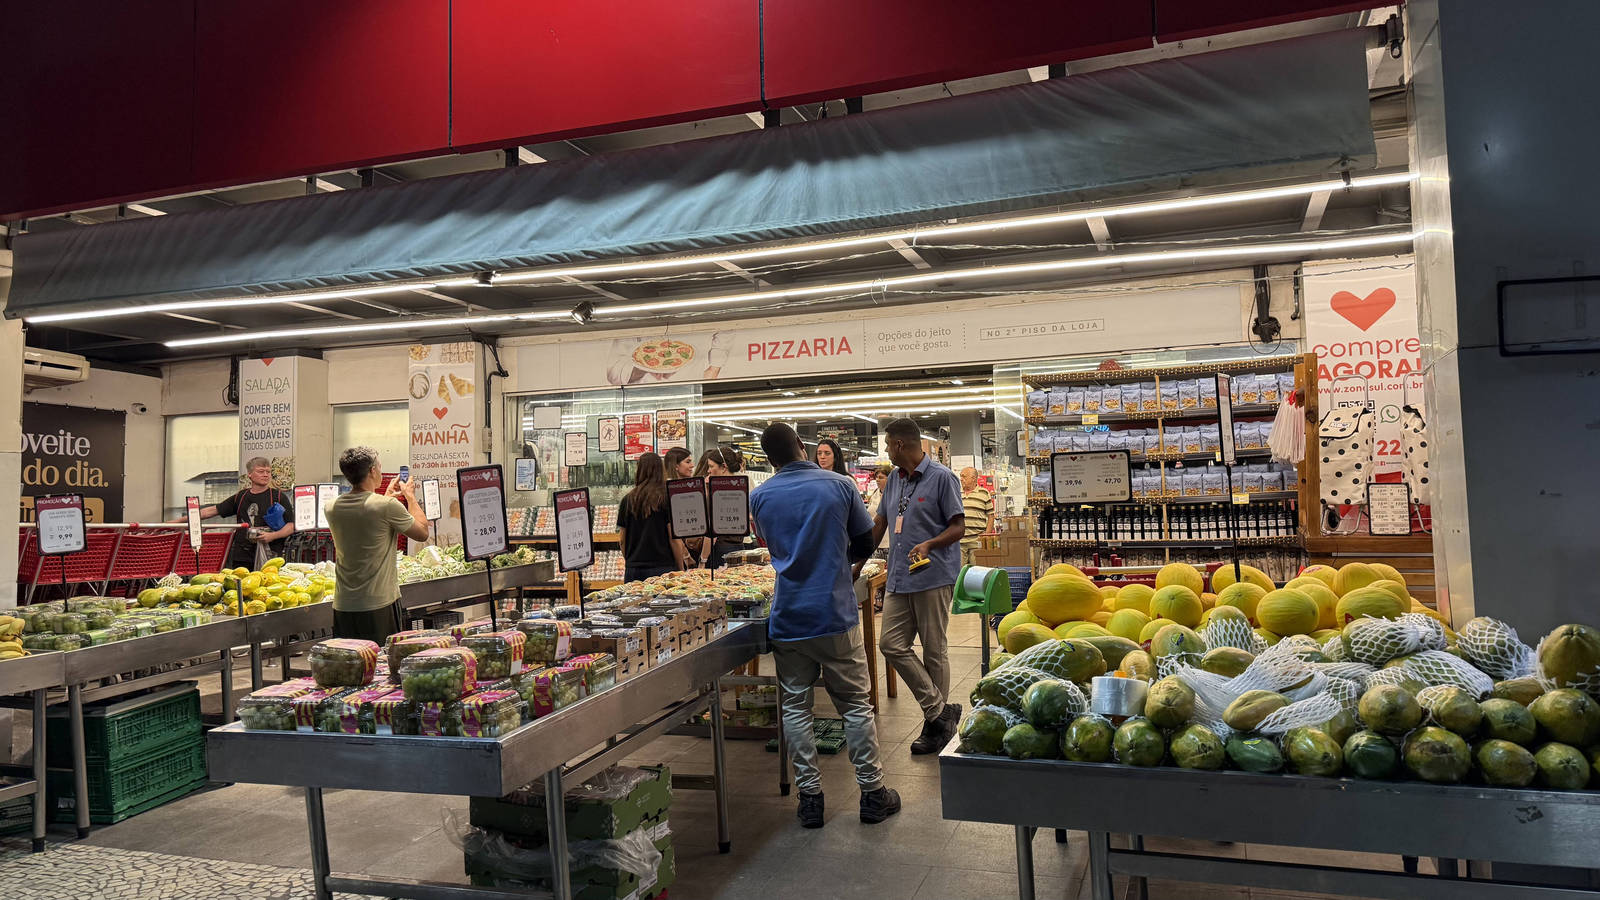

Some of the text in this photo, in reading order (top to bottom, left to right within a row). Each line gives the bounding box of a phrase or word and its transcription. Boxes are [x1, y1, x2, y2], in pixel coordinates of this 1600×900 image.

[878, 328, 952, 342] Opções do jeito
[1022, 326, 1046, 334] PISO
[1052, 324, 1066, 332] DA
[1071, 322, 1098, 330] LOJA
[748, 336, 852, 362] PIZZARIA
[878, 340, 952, 355] que você gosta.
[1312, 338, 1420, 360] compre
[1318, 358, 1424, 382] AGORA!
[244, 376, 291, 392] SALADA
[244, 402, 291, 416] COMER BEM
[244, 414, 291, 428] COM OPÇÕES
[244, 427, 290, 441] SAUDÁVEIS
[412, 422, 471, 446] MANHÃ
[244, 440, 290, 451] TODOS OS DIAS
[1376, 439, 1402, 456] 22
[412, 452, 442, 460] SEGUNDA
[448, 452, 470, 460] SEXTA
[24, 458, 109, 488] do dia.
